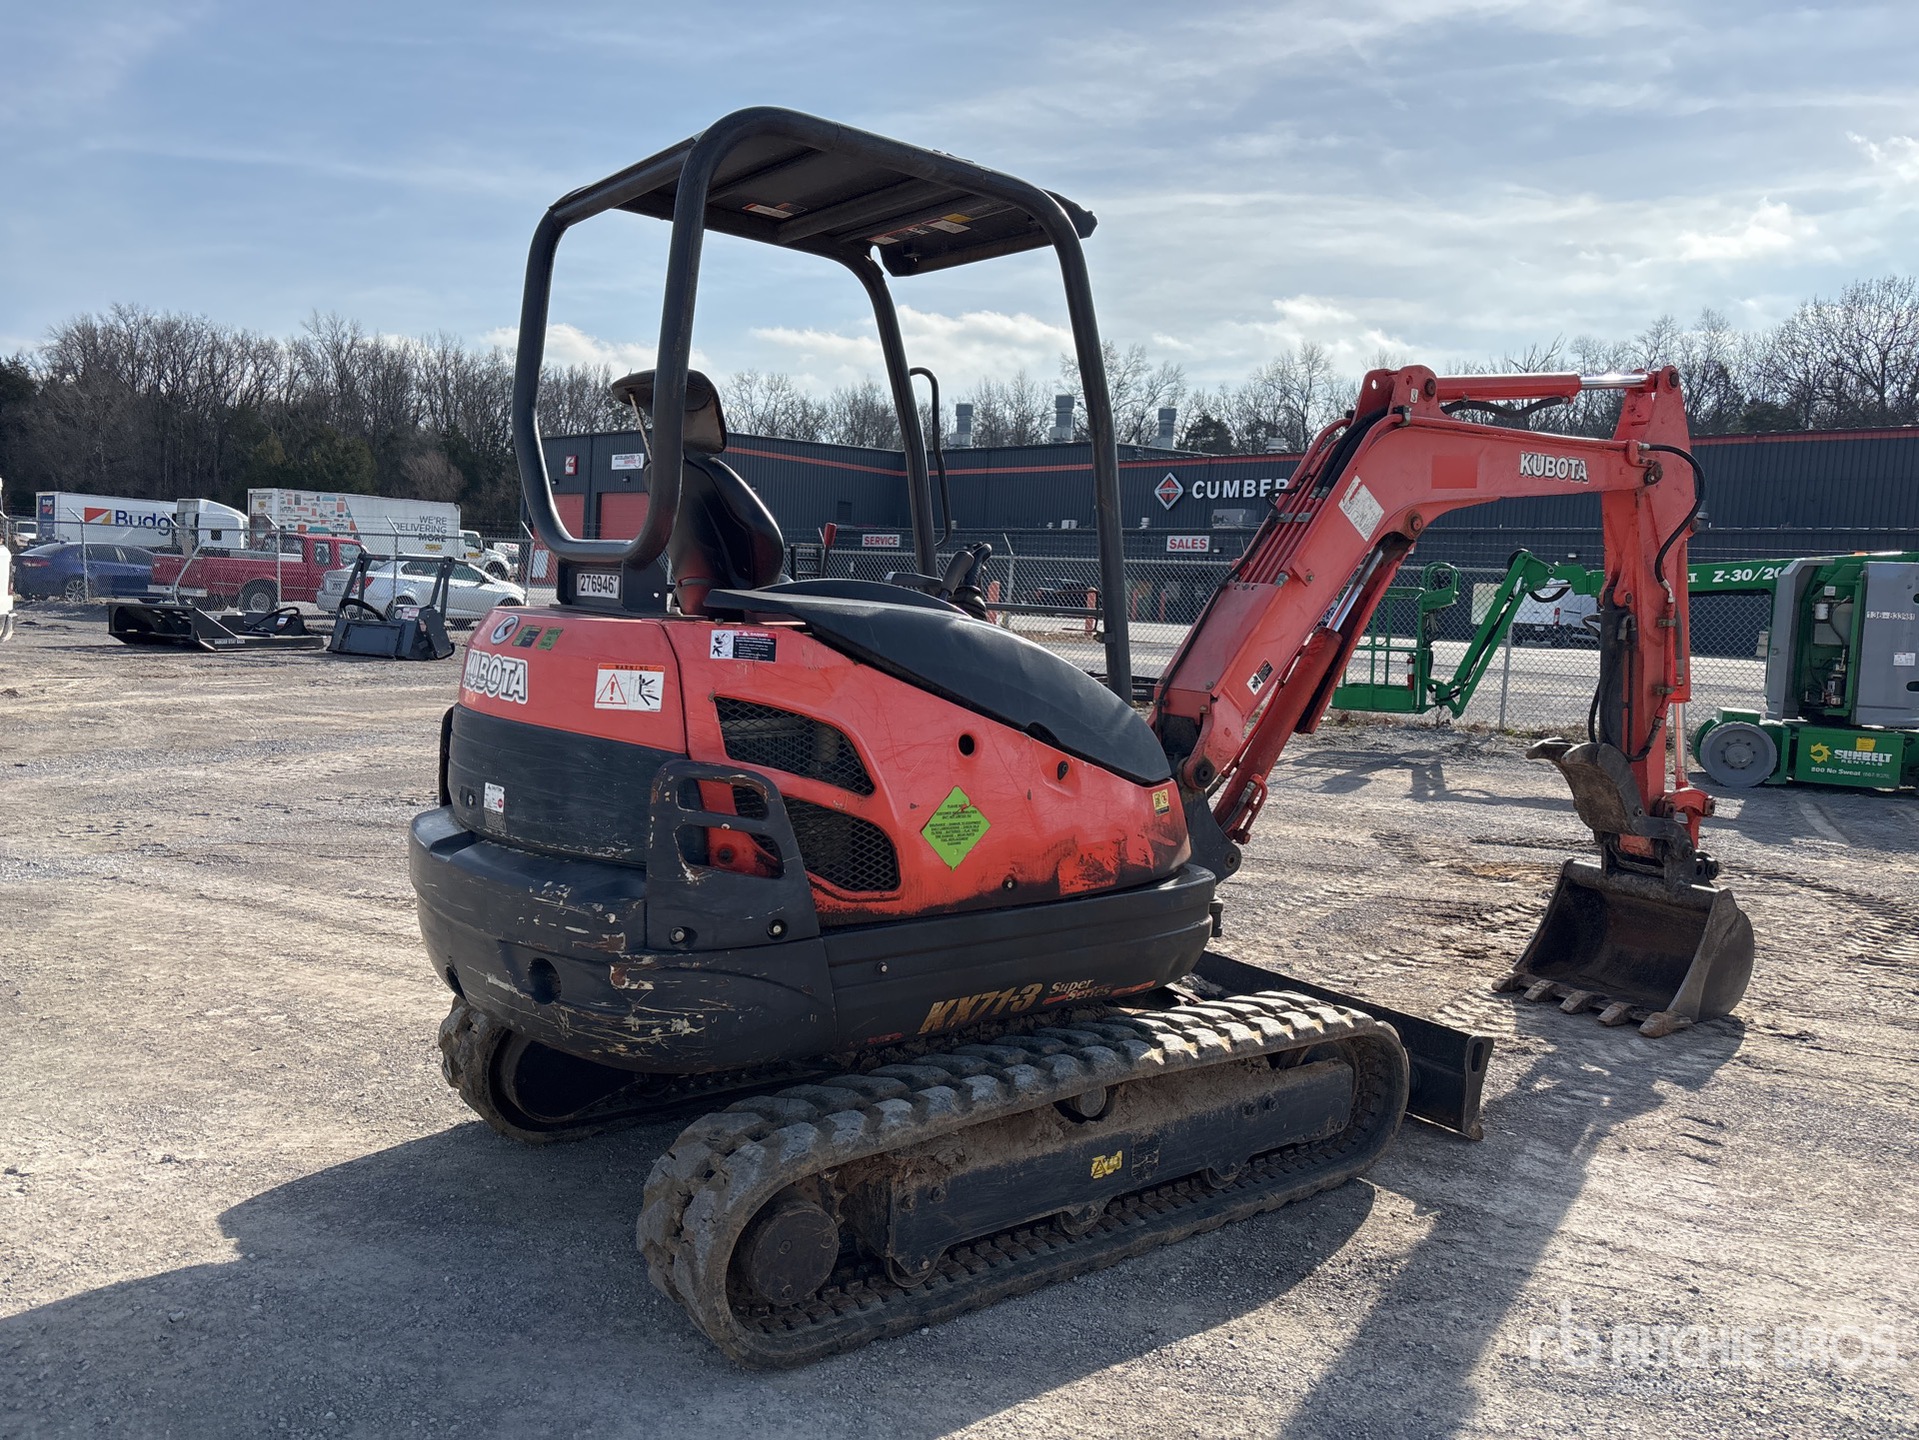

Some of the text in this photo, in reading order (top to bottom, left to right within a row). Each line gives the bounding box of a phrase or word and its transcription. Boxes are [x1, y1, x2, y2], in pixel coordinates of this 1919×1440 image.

[1519, 452, 1589, 482] KUBOTA
[419, 515, 448, 526] WE'RE
[393, 522, 448, 534] DELIVERING
[864, 535, 898, 546] SERVICE
[1169, 538, 1207, 550] SALES
[463, 648, 529, 704] KUBOTA
[1834, 749, 1893, 763] SUNBELT
[1838, 768, 1861, 776] Sweat
[1050, 979, 1095, 995] Super
[917, 983, 1043, 1034] KX71-3
